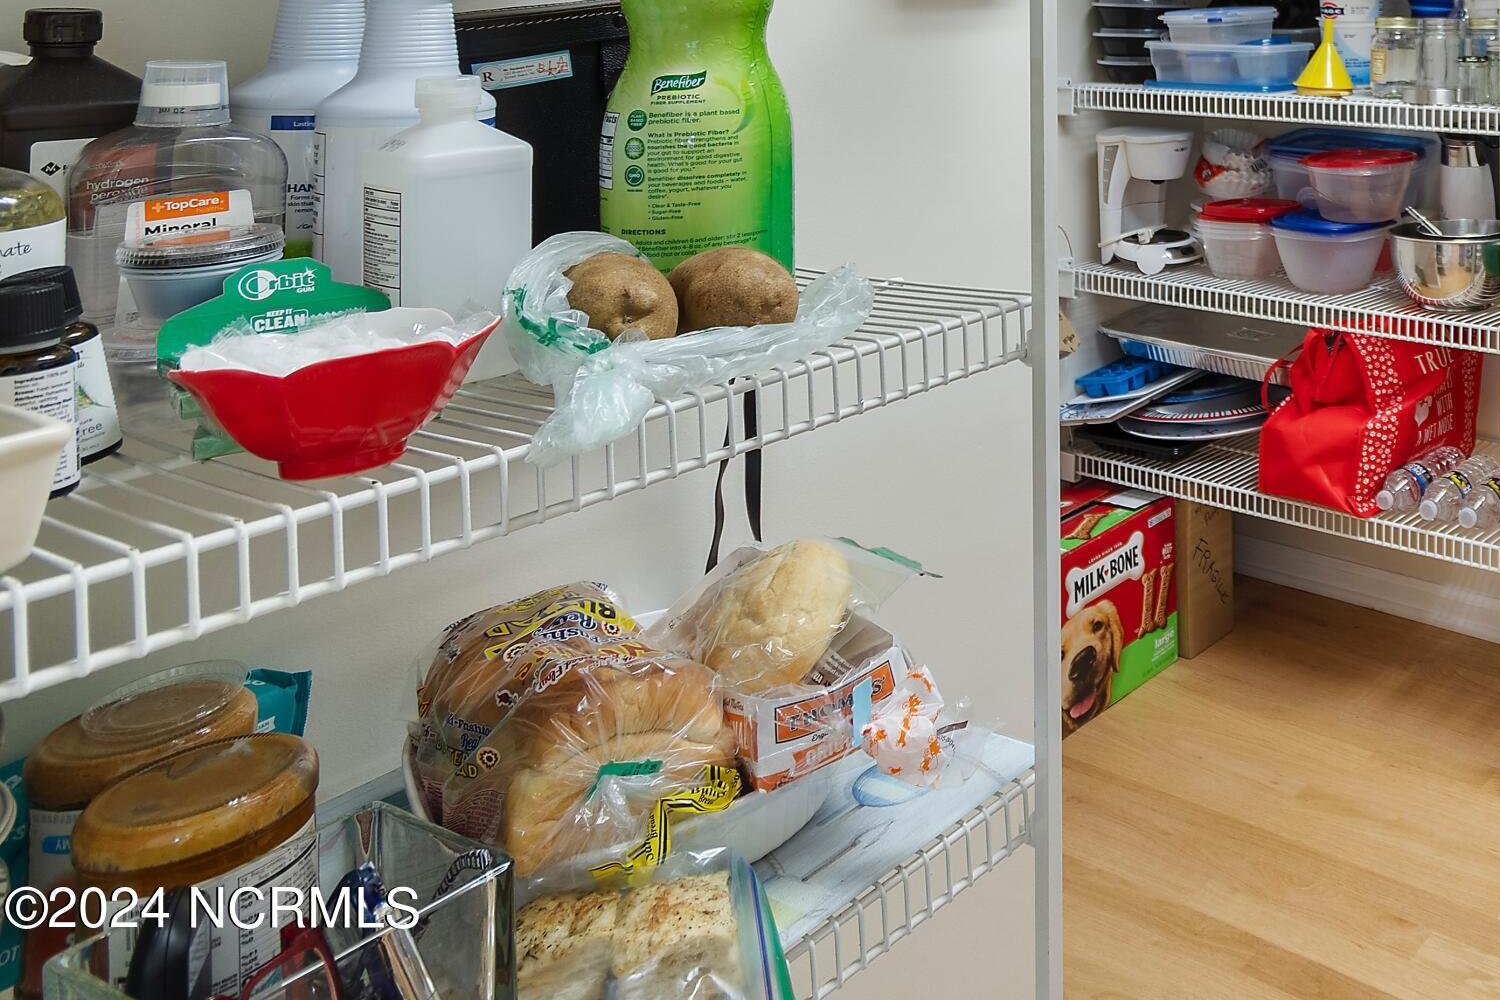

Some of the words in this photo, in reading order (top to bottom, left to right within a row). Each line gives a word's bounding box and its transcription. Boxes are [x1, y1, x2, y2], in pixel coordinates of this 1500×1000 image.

[653, 75, 705, 92] Benefiber
[699, 110, 717, 118] plant
[86, 176, 149, 190] hydrogen
[288, 183, 314, 193] HAN
[144, 218, 216, 236] Mineral
[239, 267, 316, 301] Orbit
[285, 308, 293, 316] IT
[254, 313, 306, 331] CLEAN
[1414, 347, 1454, 374] TRUE
